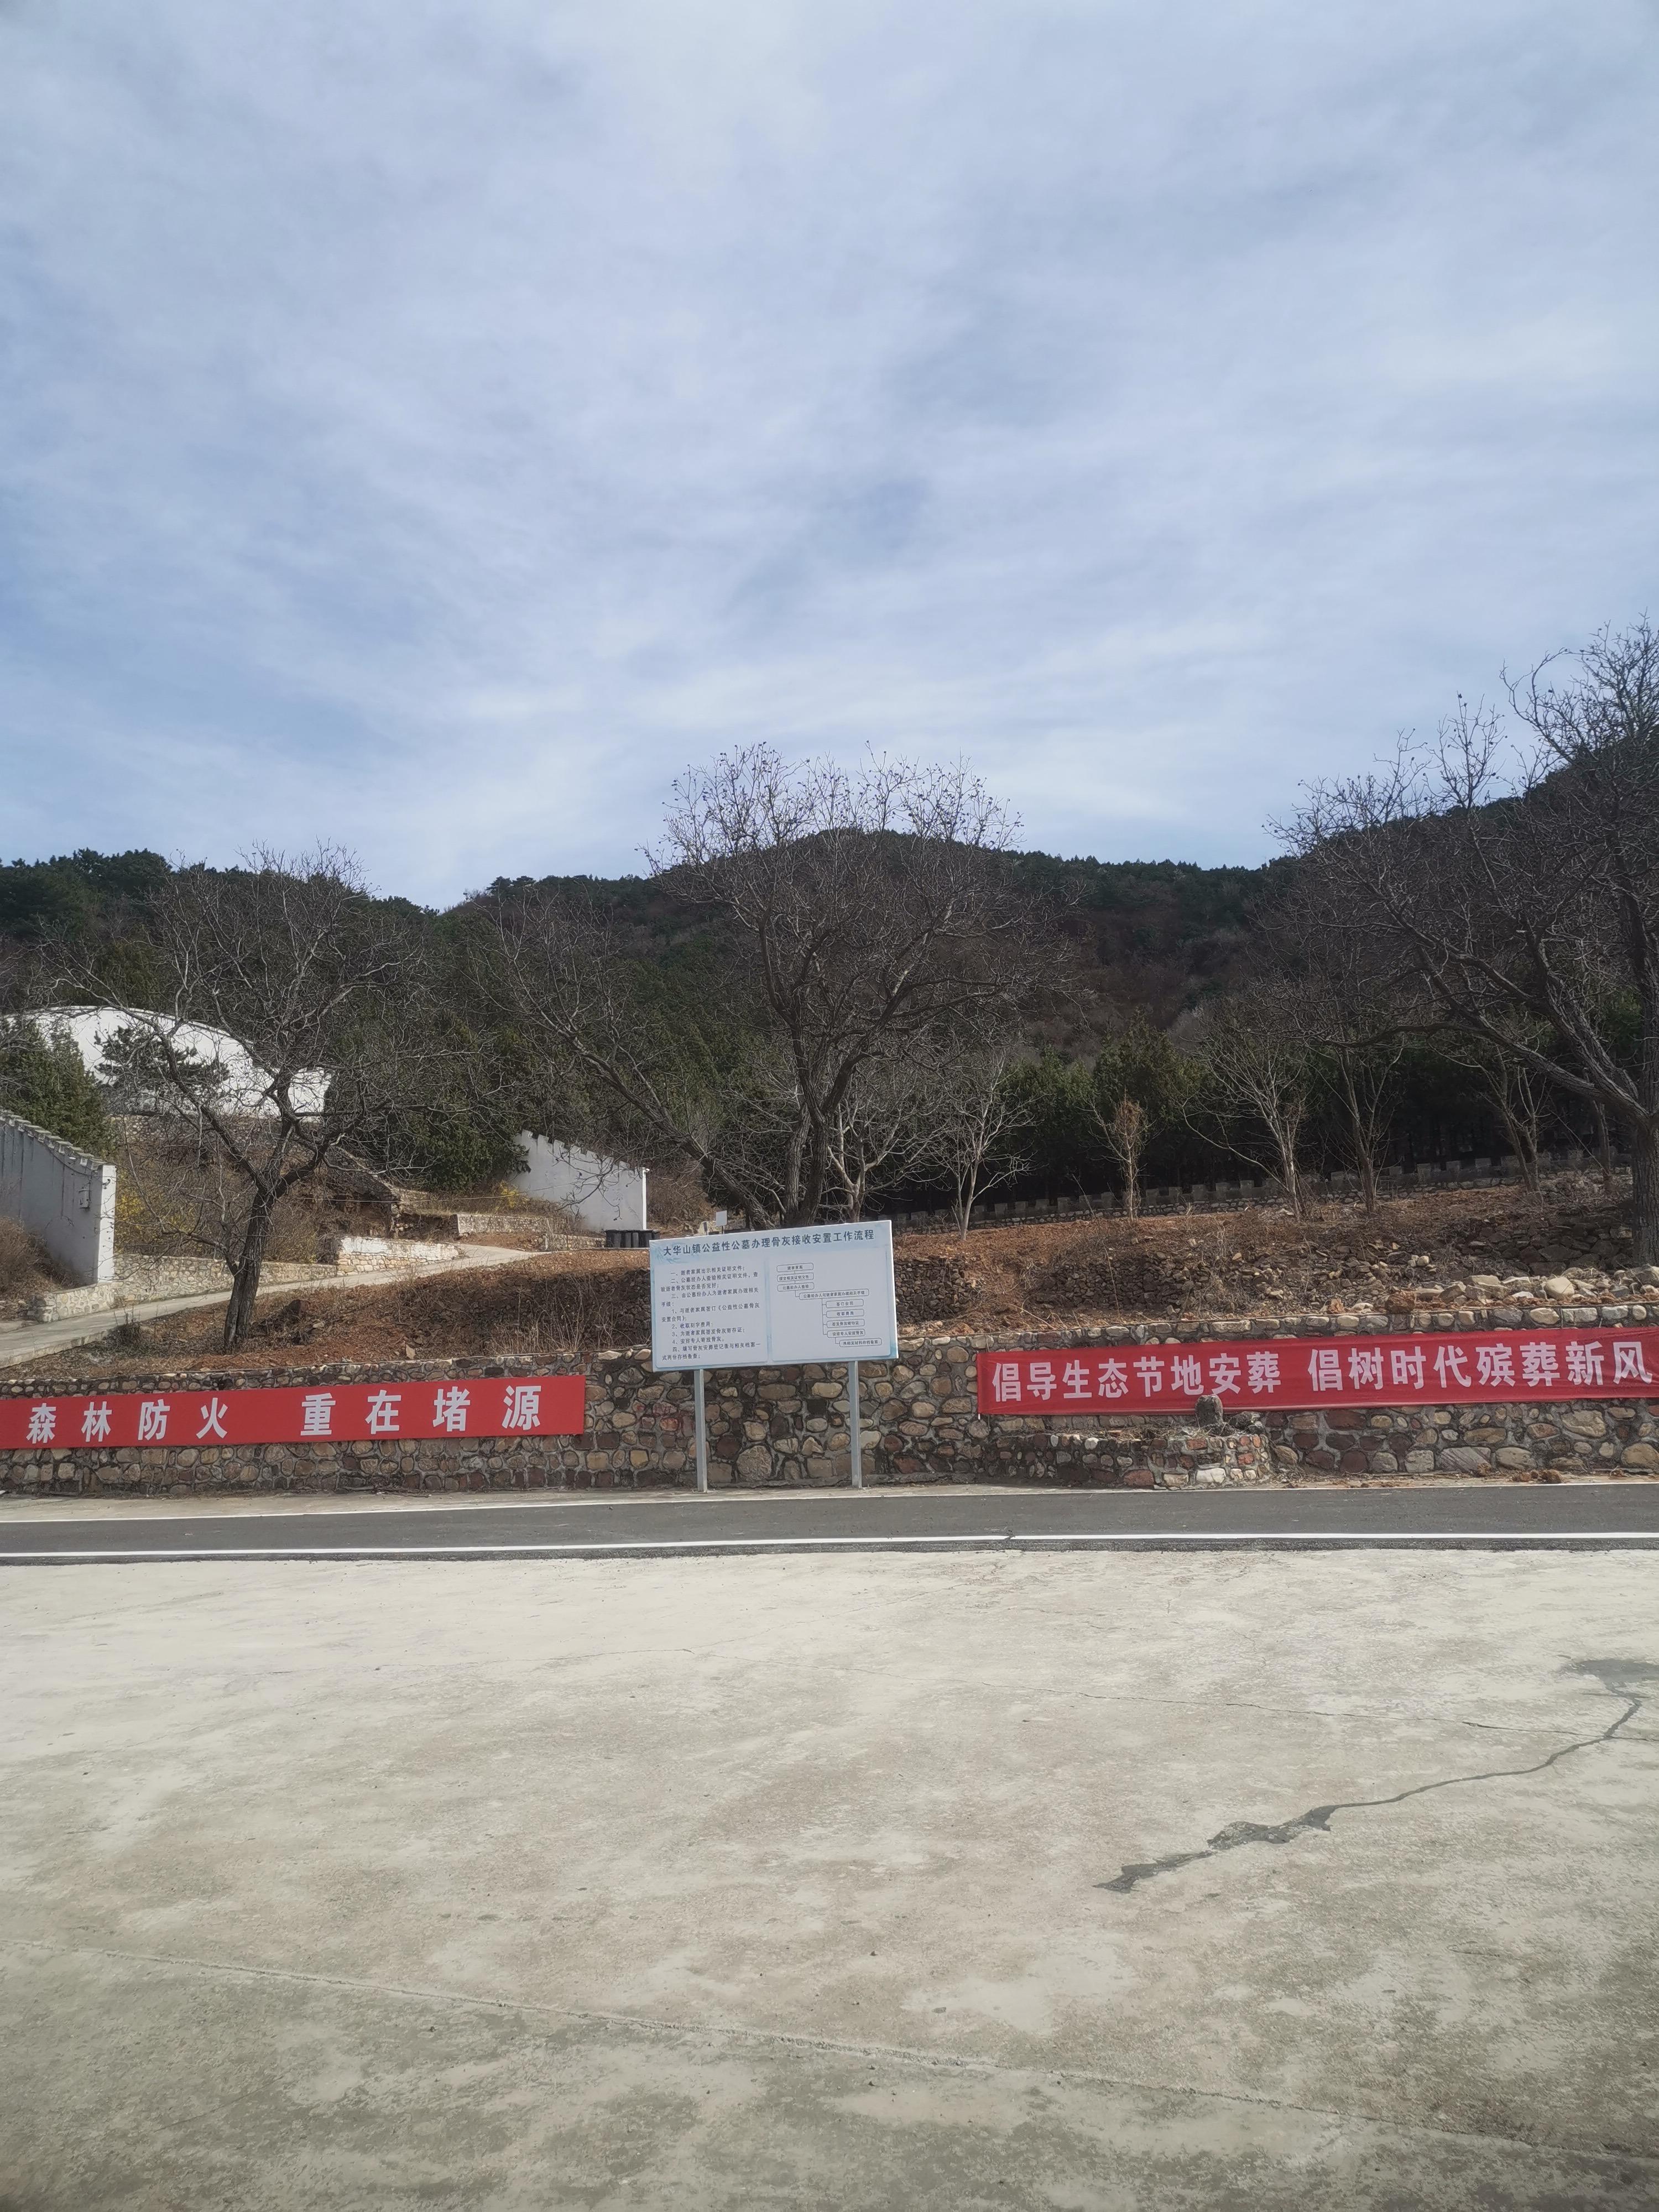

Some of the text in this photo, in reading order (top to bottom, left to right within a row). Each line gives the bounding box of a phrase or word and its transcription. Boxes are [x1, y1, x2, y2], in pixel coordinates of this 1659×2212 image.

[664, 1230, 874, 1256] 大华山镇公益性公墓办理骨灰接收安置工作流程
[992, 1341, 1652, 1402] 倡导生态节地安葬 倡树时代殡葬新风
[26, 1385, 541, 1444] 森林防火 重在堵源
